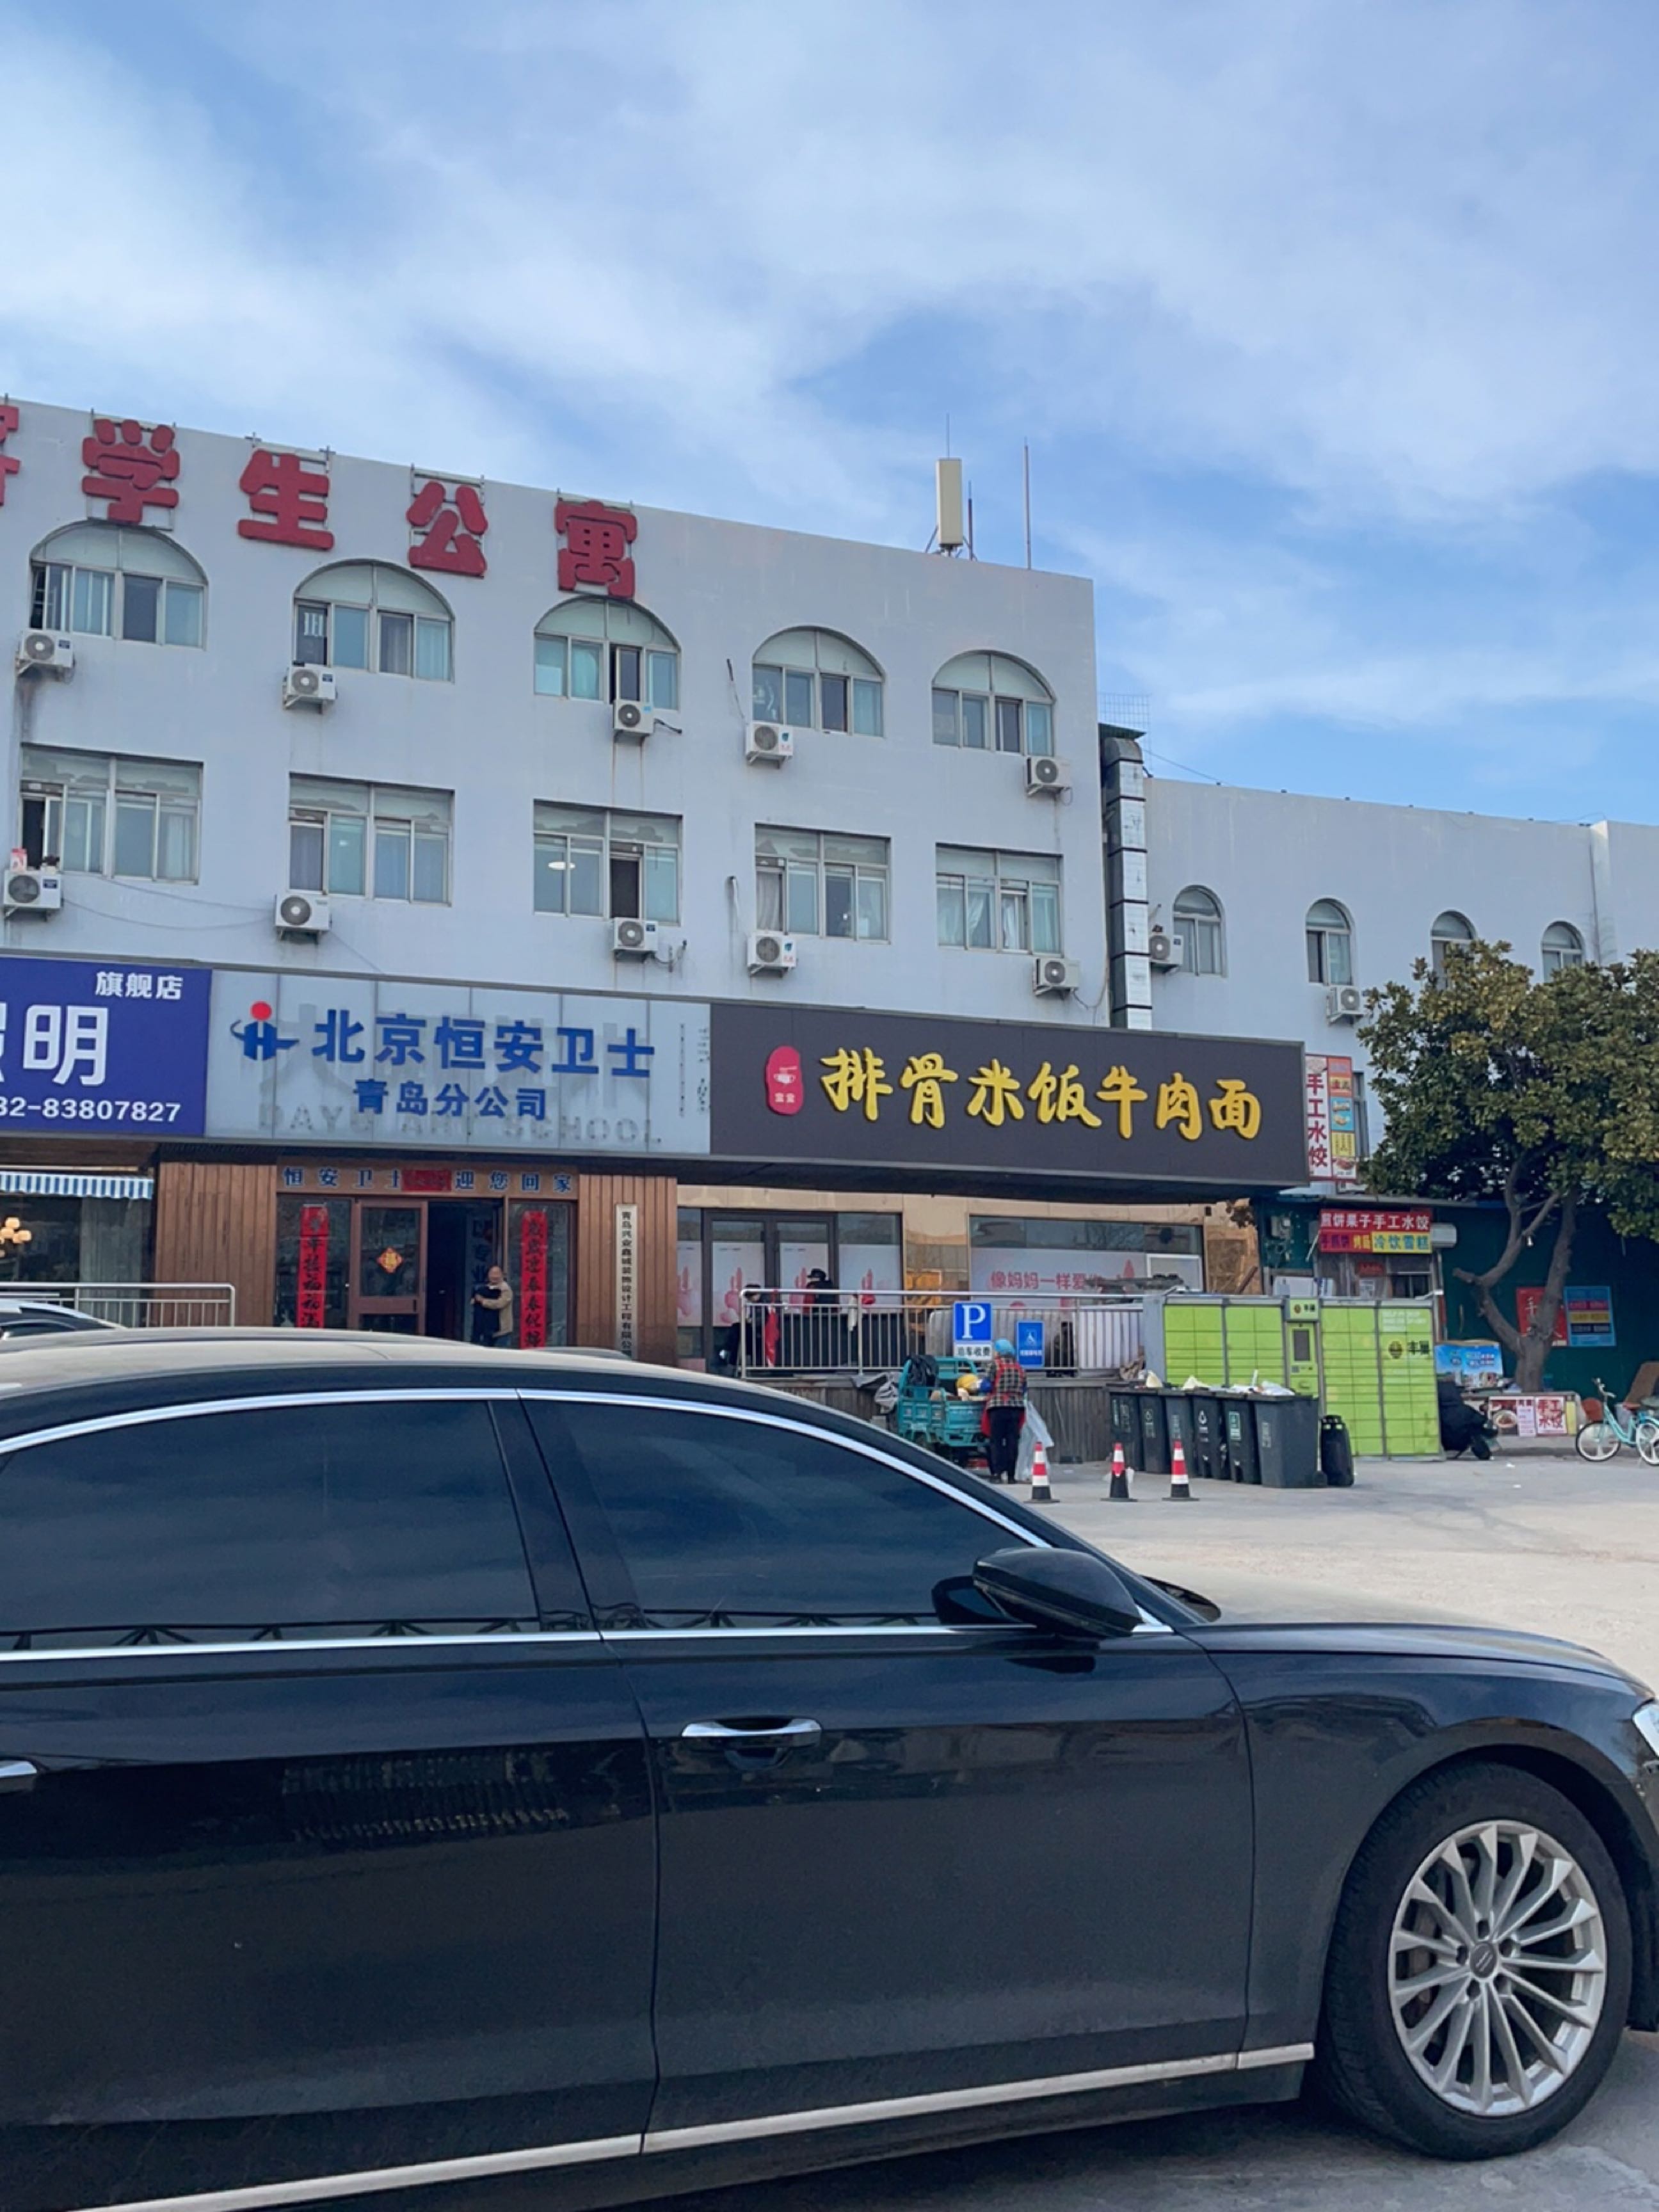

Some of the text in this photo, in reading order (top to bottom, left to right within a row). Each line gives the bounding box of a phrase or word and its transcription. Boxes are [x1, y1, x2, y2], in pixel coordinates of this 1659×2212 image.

[0, 405, 637, 600] 学生公寓
[95, 971, 183, 1000] 旗舰店
[0, 1001, 108, 1086] 明
[312, 1009, 655, 1078] 北京恒安卫士
[353, 1079, 547, 1121] 青岛分公司
[819, 1046, 1263, 1141] 排骨米饭牛肉面
[1306, 1073, 1328, 1168] 手工水饺
[961, 1304, 986, 1339] P
